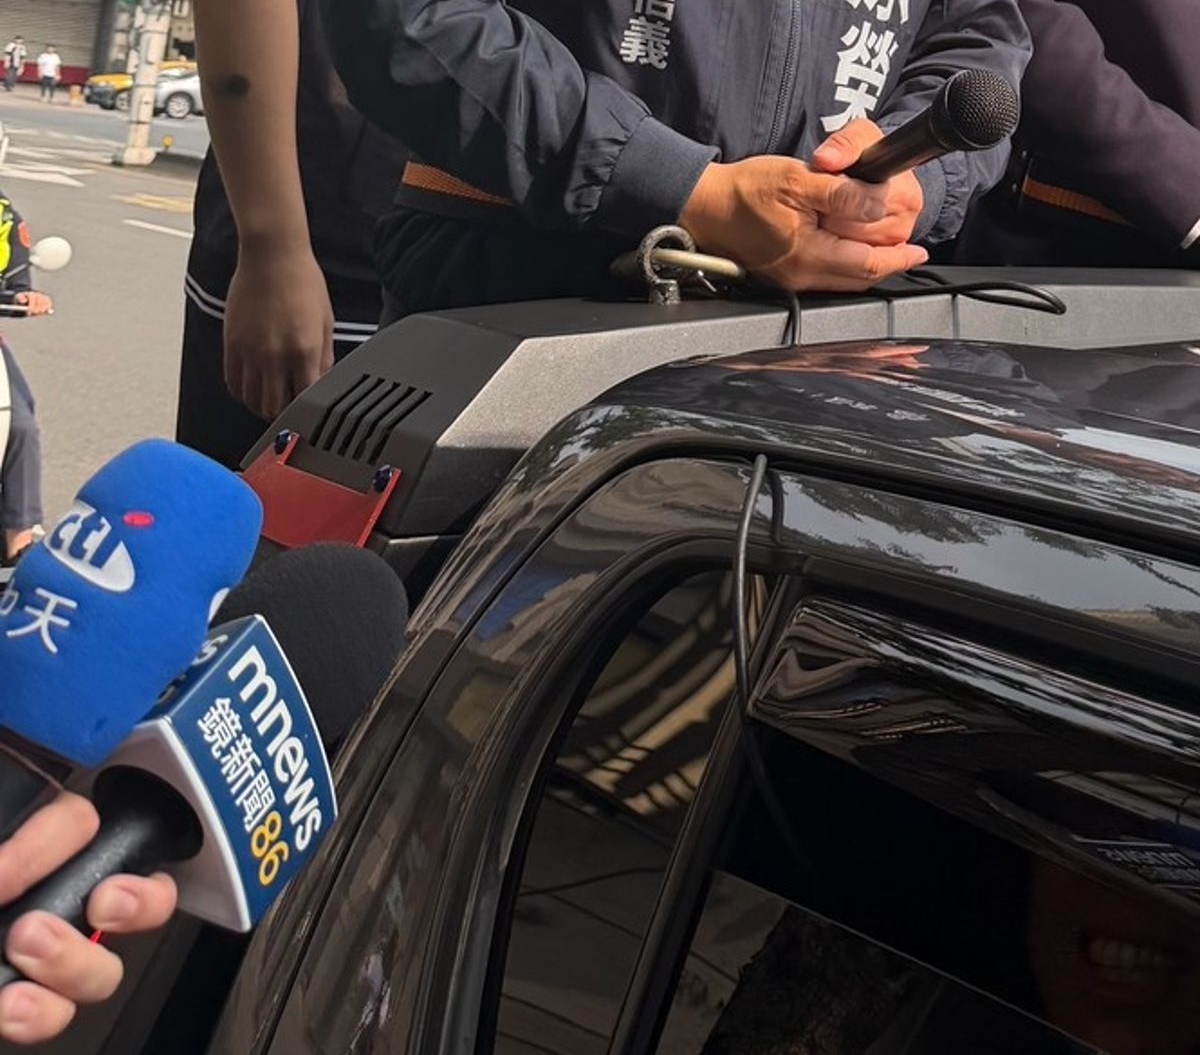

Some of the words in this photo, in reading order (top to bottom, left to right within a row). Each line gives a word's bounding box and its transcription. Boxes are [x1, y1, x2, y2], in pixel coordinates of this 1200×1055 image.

[197, 697, 277, 834] 鏡新聞
[228, 645, 323, 851] mnews
[249, 810, 292, 887] 86
